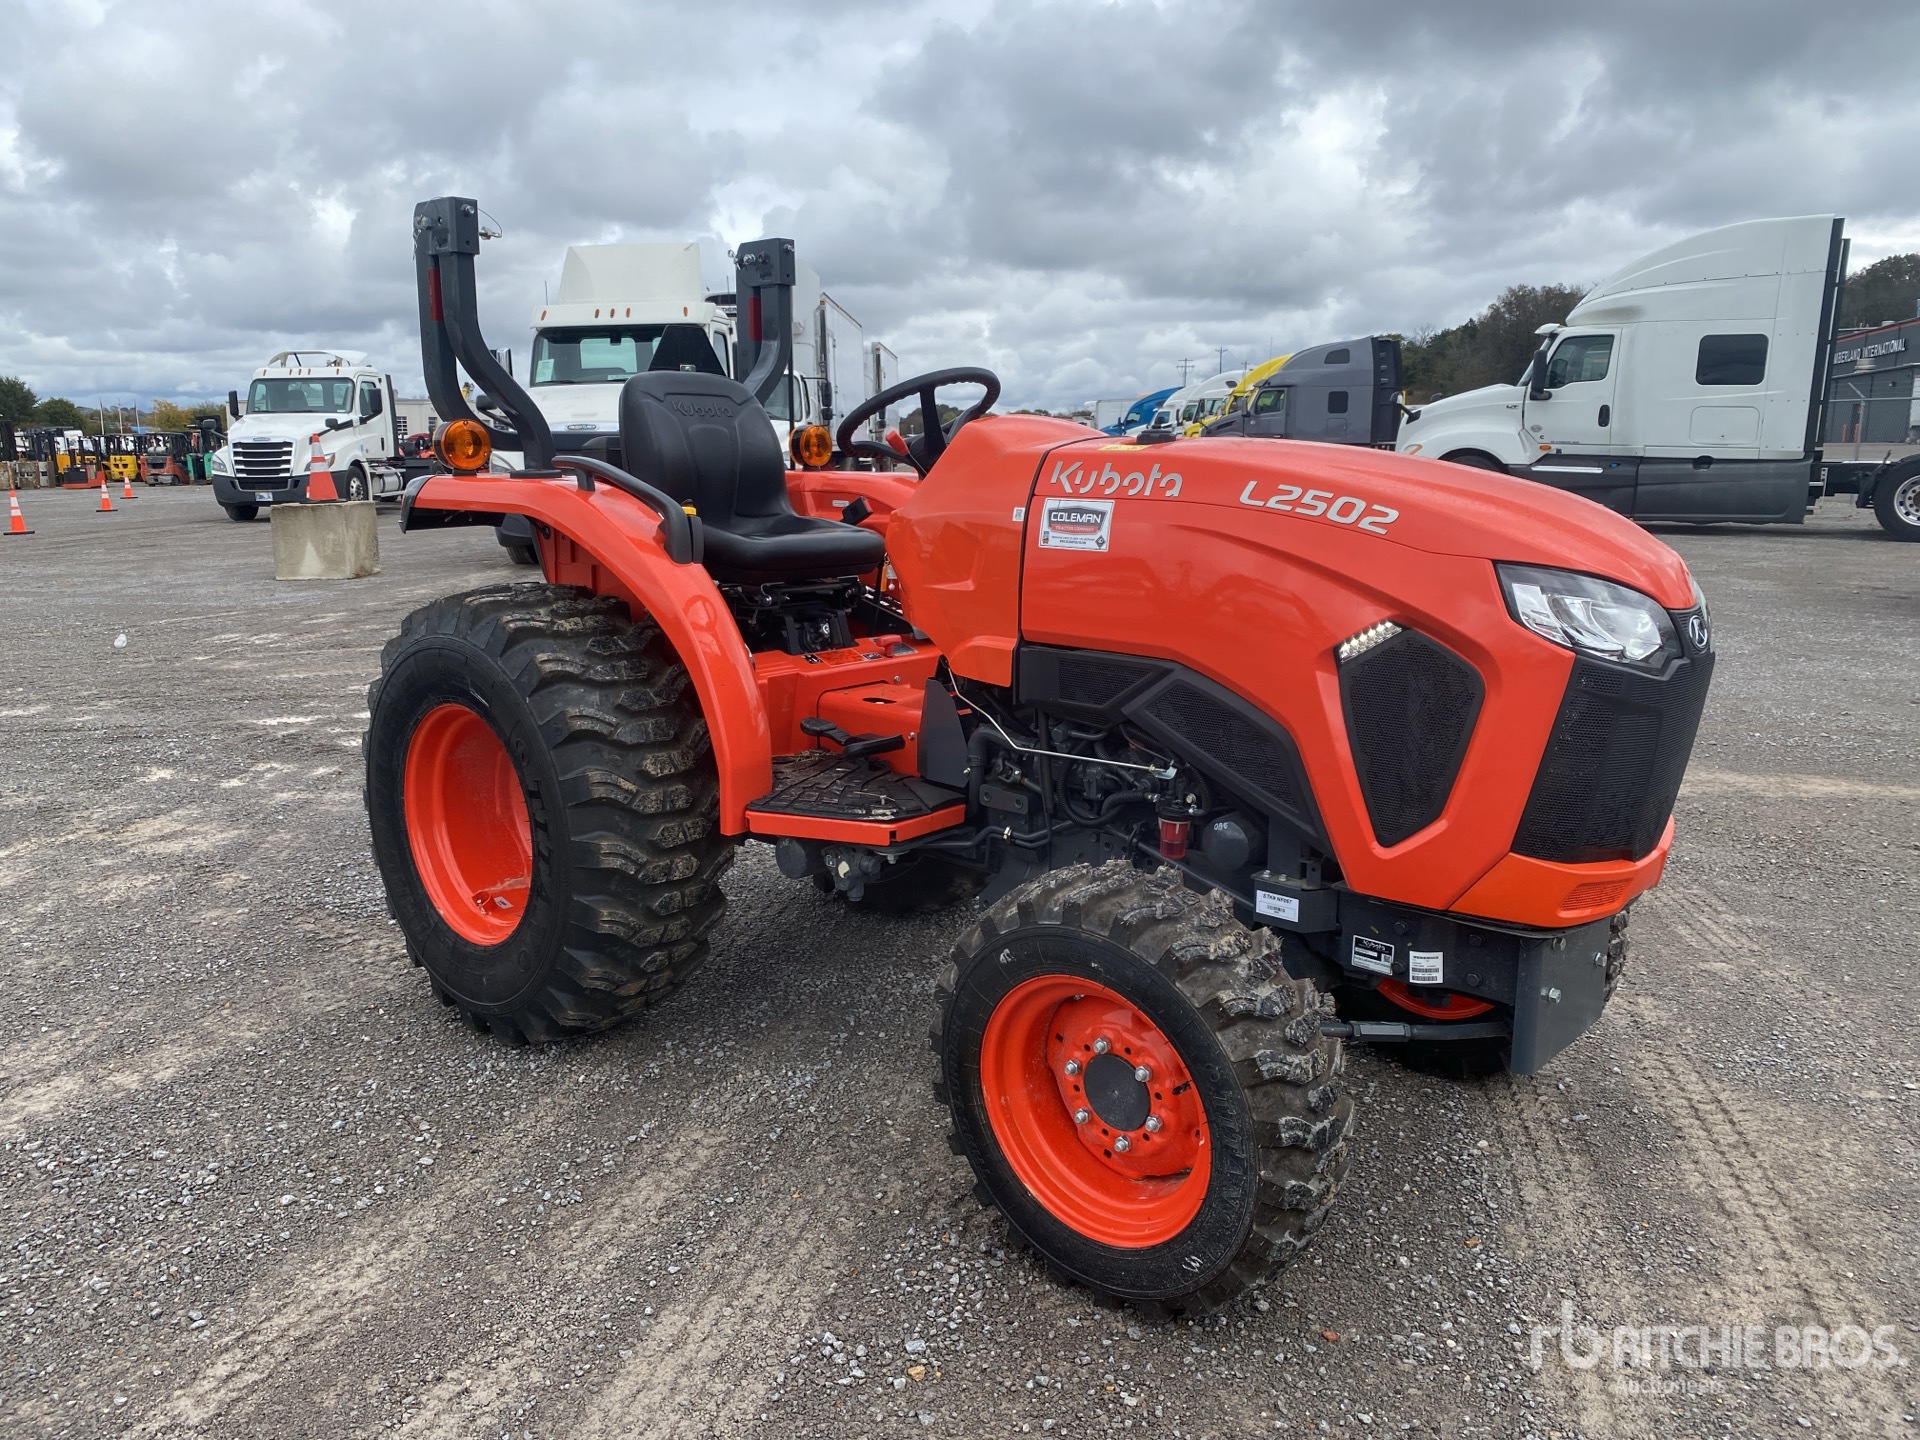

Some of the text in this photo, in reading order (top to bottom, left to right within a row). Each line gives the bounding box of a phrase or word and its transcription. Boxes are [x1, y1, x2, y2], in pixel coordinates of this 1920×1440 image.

[1862, 338, 1906, 359] INTERNATIONAL
[671, 400, 733, 418] Kubota
[1051, 460, 1183, 497] Kubota
[1051, 512, 1101, 523] COLEMAN
[1239, 479, 1399, 535] L2502
